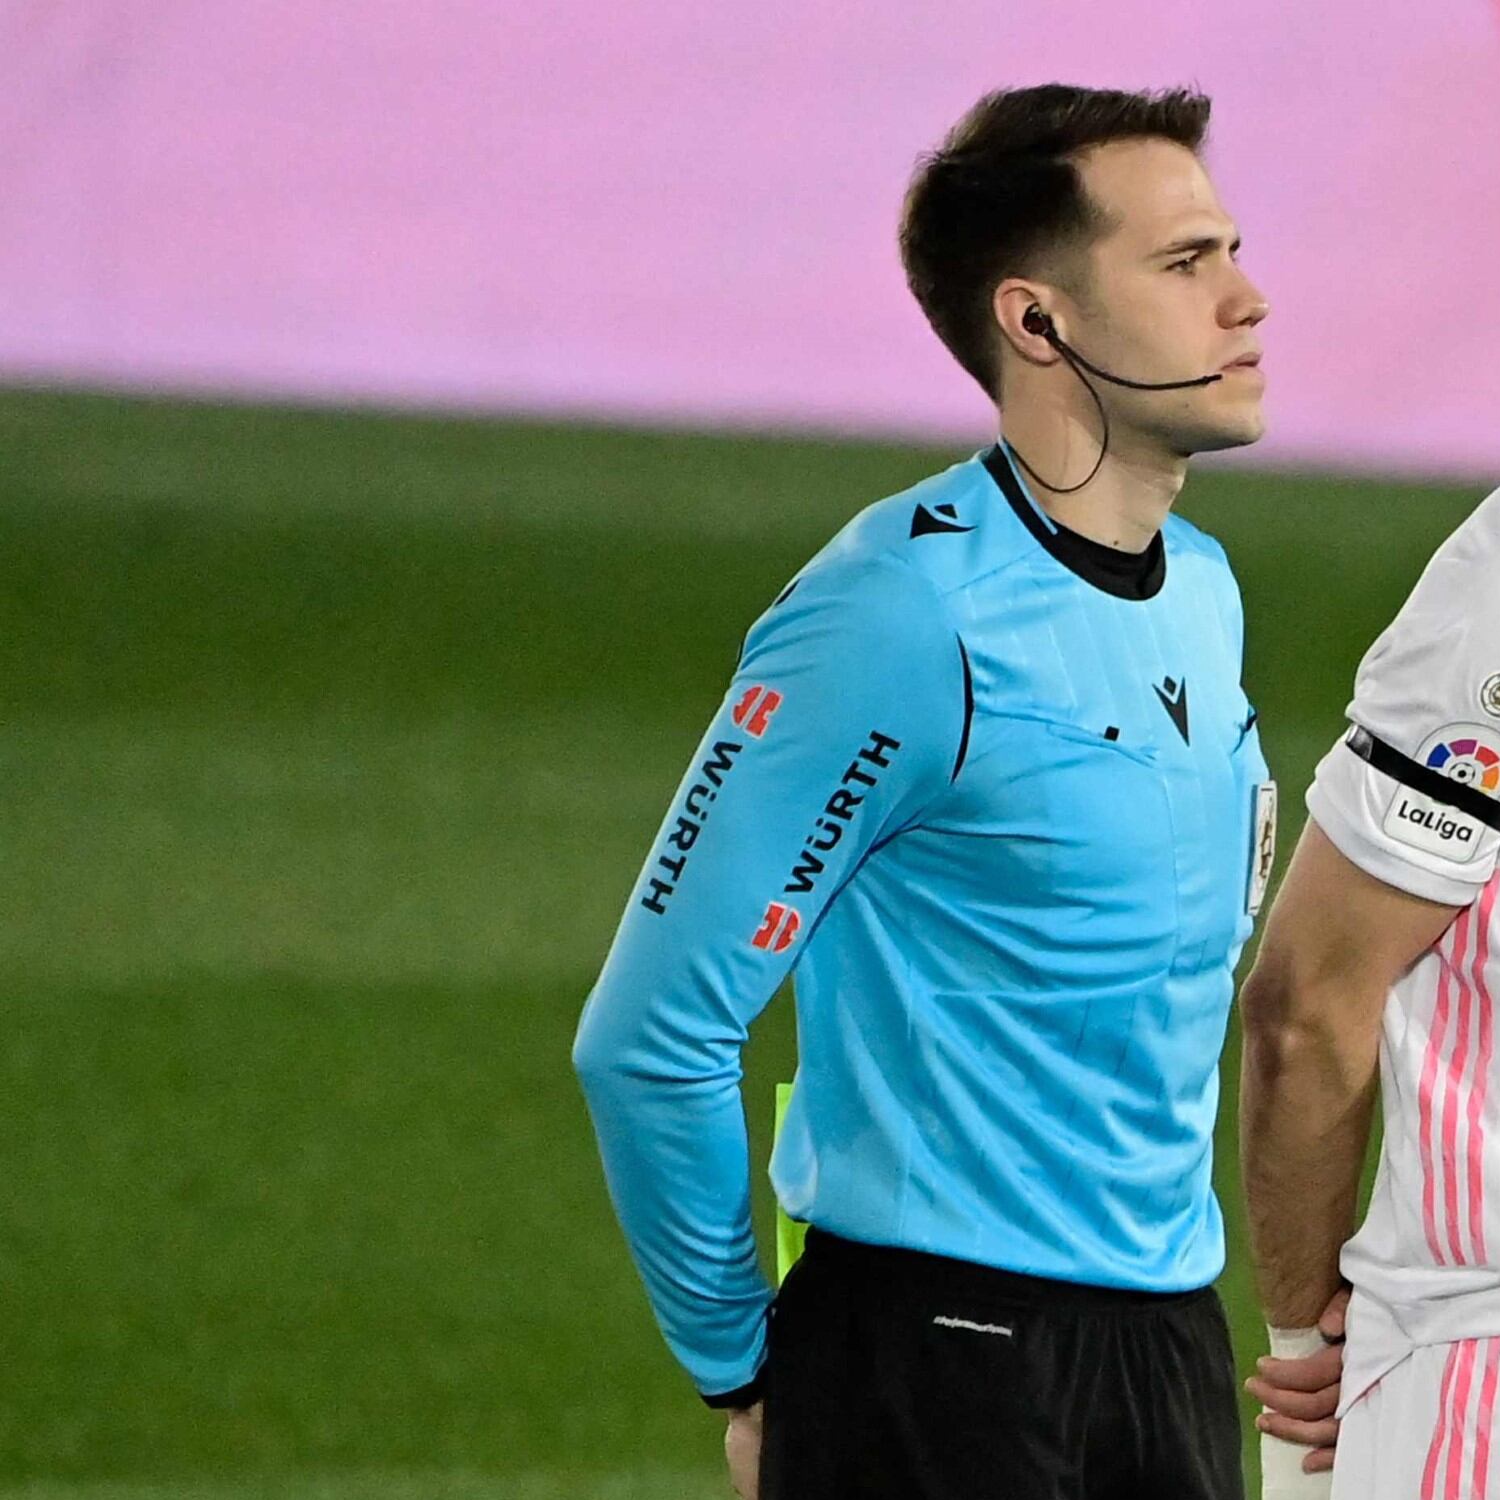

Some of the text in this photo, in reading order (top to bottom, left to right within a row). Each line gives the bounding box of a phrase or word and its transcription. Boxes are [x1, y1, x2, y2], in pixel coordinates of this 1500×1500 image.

[640, 740, 743, 916] WÜRTH
[783, 730, 902, 893] WÜRTH
[1397, 800, 1474, 842] LaLiga
